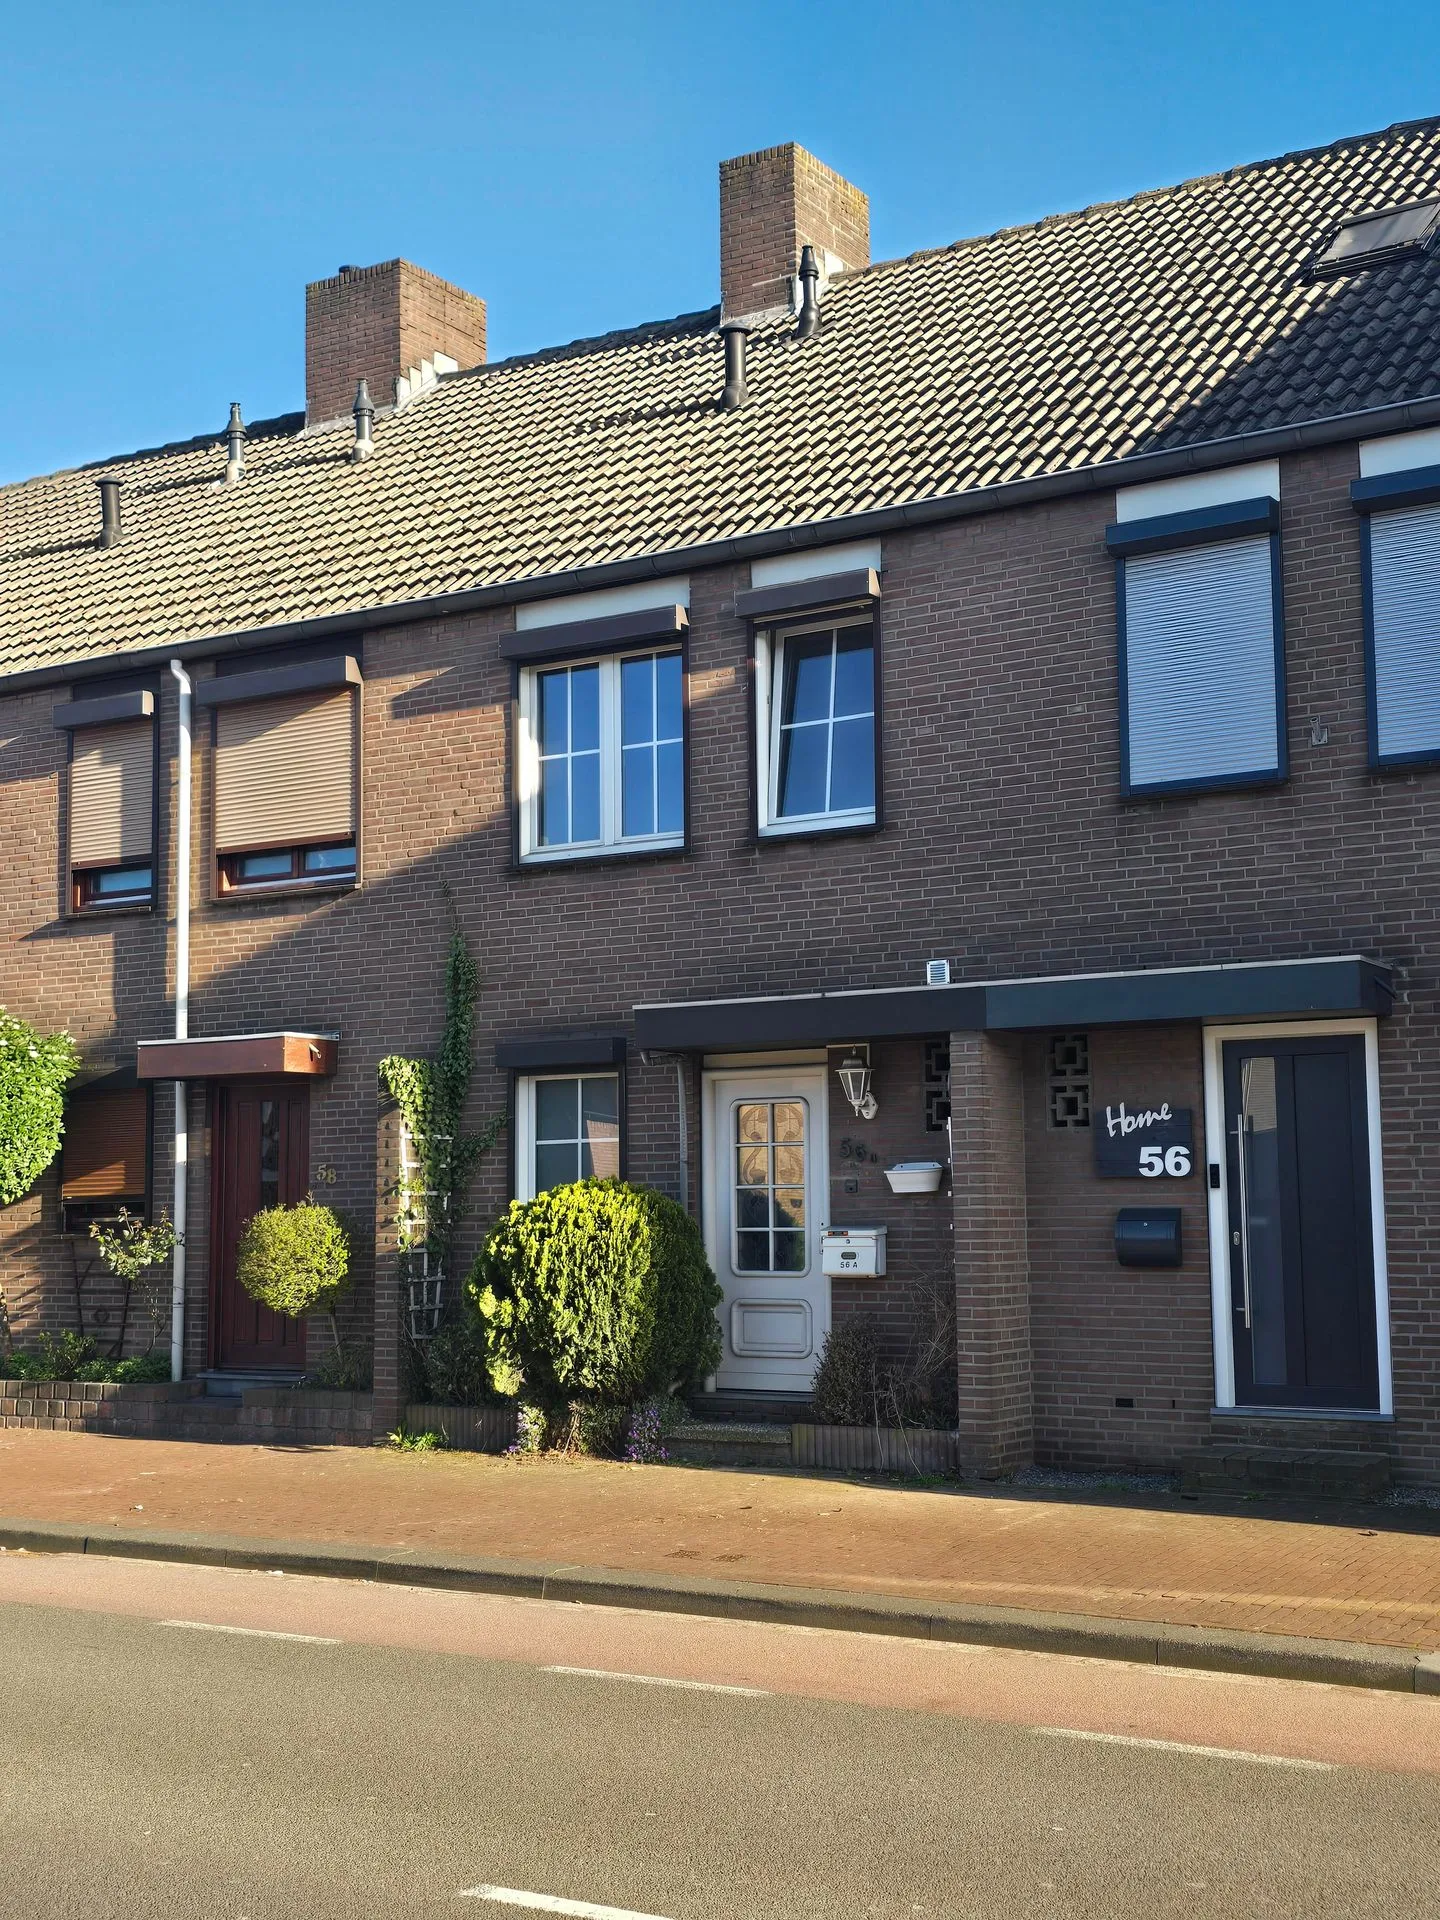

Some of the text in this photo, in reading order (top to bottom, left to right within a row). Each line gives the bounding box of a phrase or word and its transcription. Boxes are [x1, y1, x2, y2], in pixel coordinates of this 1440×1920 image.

[1106, 1102, 1172, 1137] Home
[316, 1164, 337, 1184] 58
[1138, 1146, 1191, 1177] 56
[840, 1261, 858, 1269] 56 A
